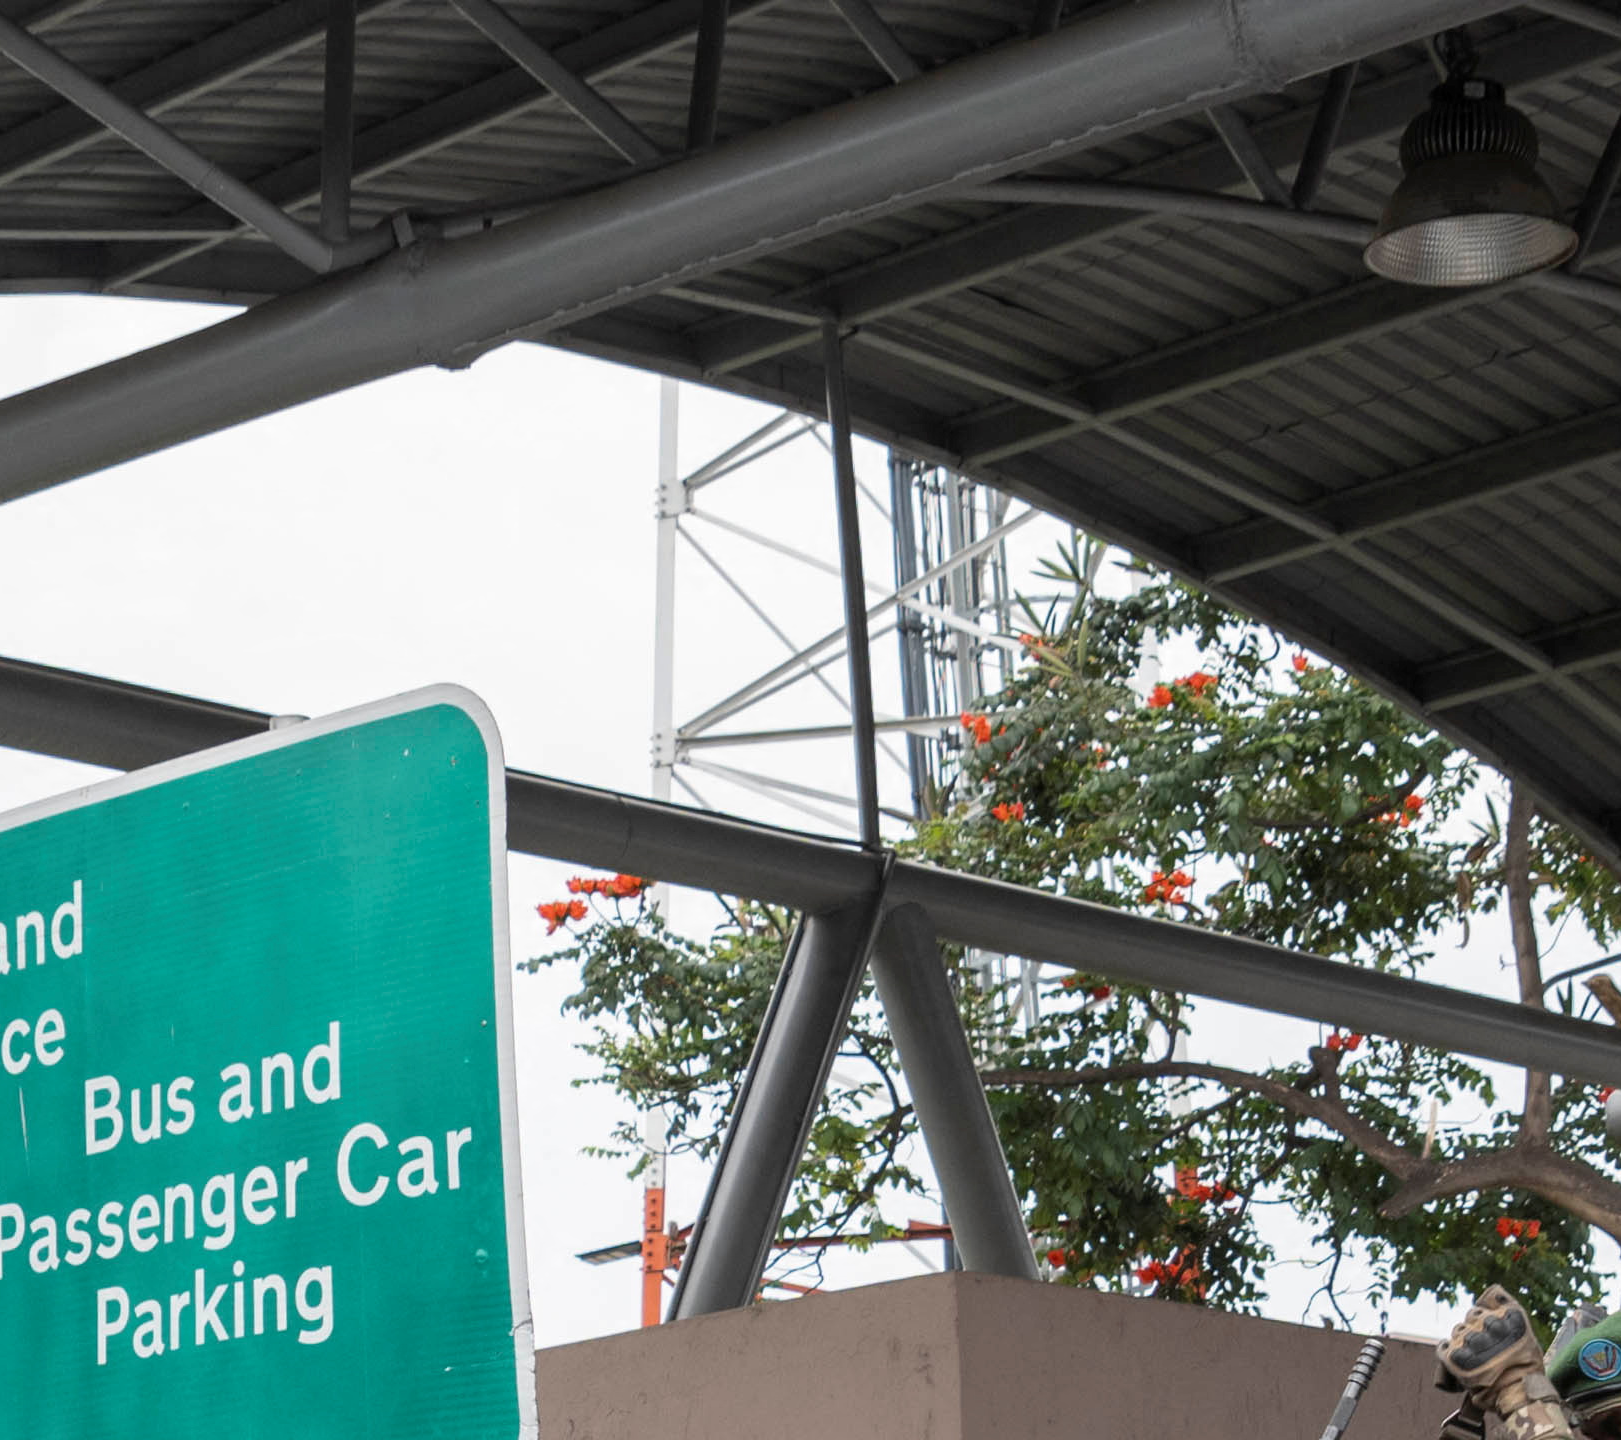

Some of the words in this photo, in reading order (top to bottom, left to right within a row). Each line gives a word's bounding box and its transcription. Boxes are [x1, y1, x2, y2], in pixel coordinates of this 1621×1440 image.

[85, 1075, 195, 1155] Bus
[219, 1021, 341, 1121] and
[337, 1122, 473, 1206] Car
[97, 1262, 334, 1365] Parking
